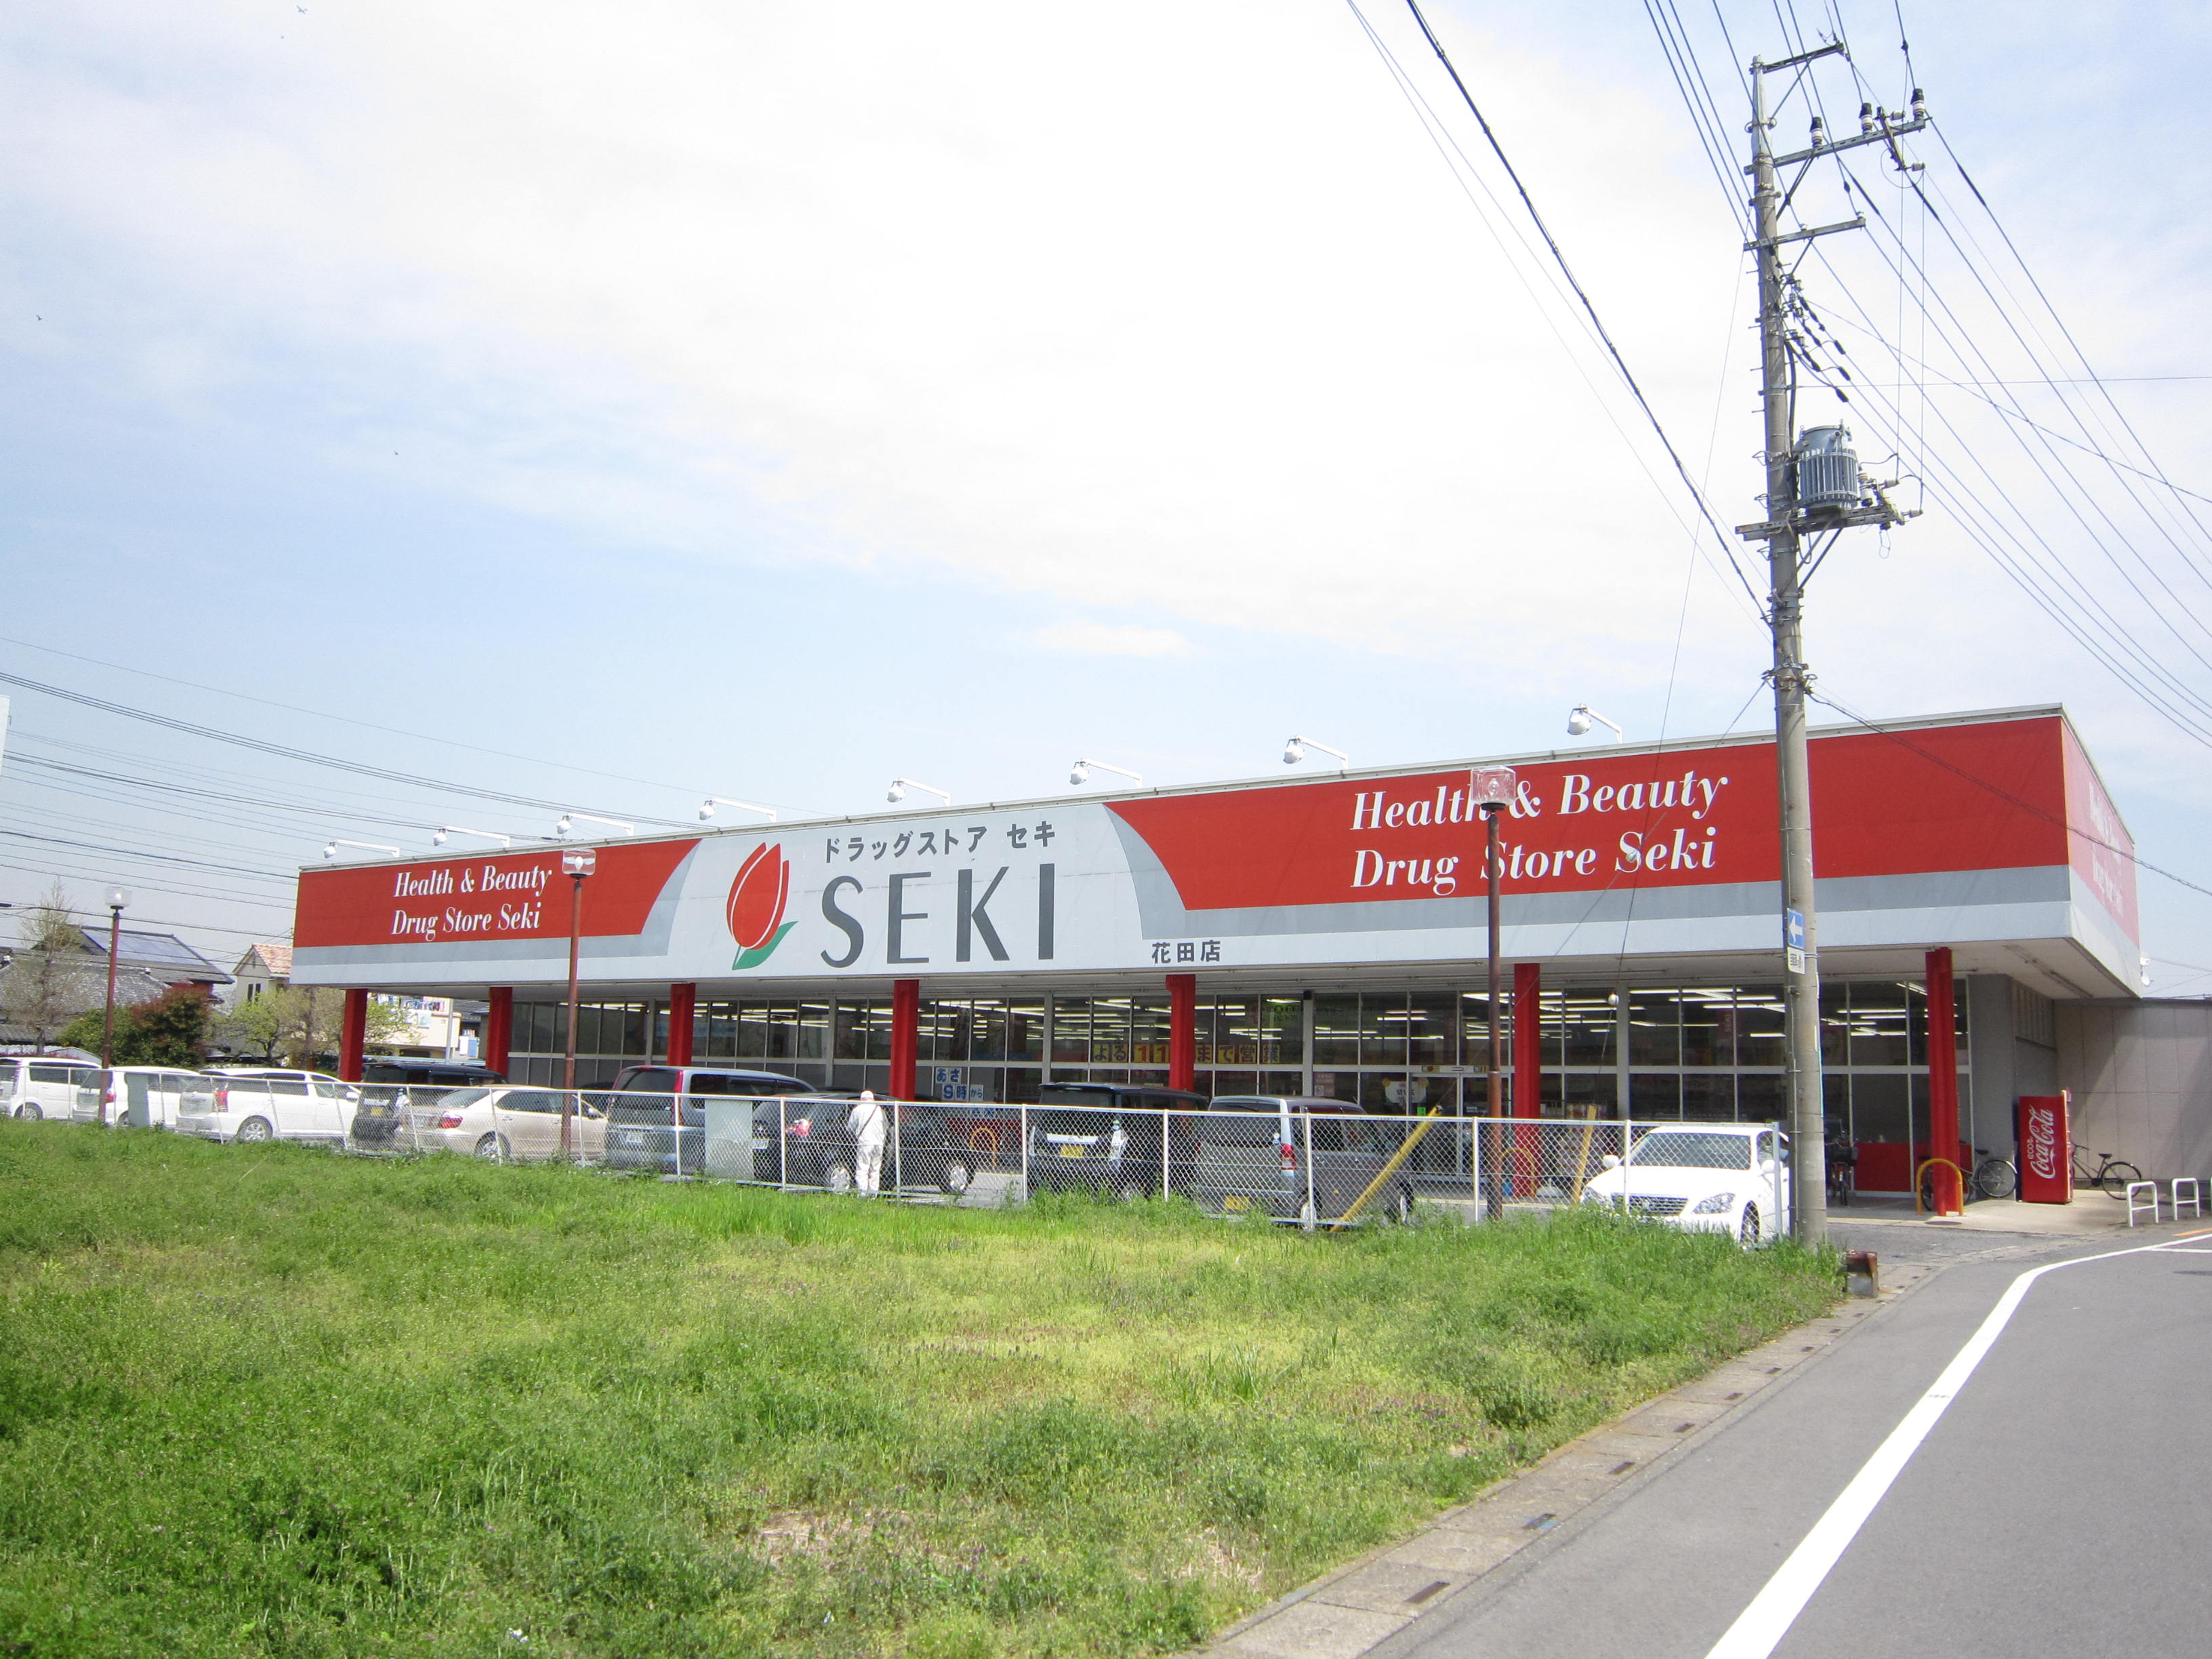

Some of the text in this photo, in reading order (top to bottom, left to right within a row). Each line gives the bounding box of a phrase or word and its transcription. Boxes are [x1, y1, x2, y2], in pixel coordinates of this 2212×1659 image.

[1509, 780, 1541, 819] &
[1557, 770, 1729, 819] Beauty
[825, 820, 1055, 863] ドラッグストア セキ
[1350, 826, 1717, 896] Drug Store Seki
[392, 865, 553, 897] Health & Beauty
[390, 901, 543, 942] Drug Store Seki
[820, 863, 1055, 968] SEKI
[1151, 939, 1221, 964] 花田店
[1094, 1044, 1280, 1063] よる11まで営業
[937, 1067, 960, 1083] あさ
